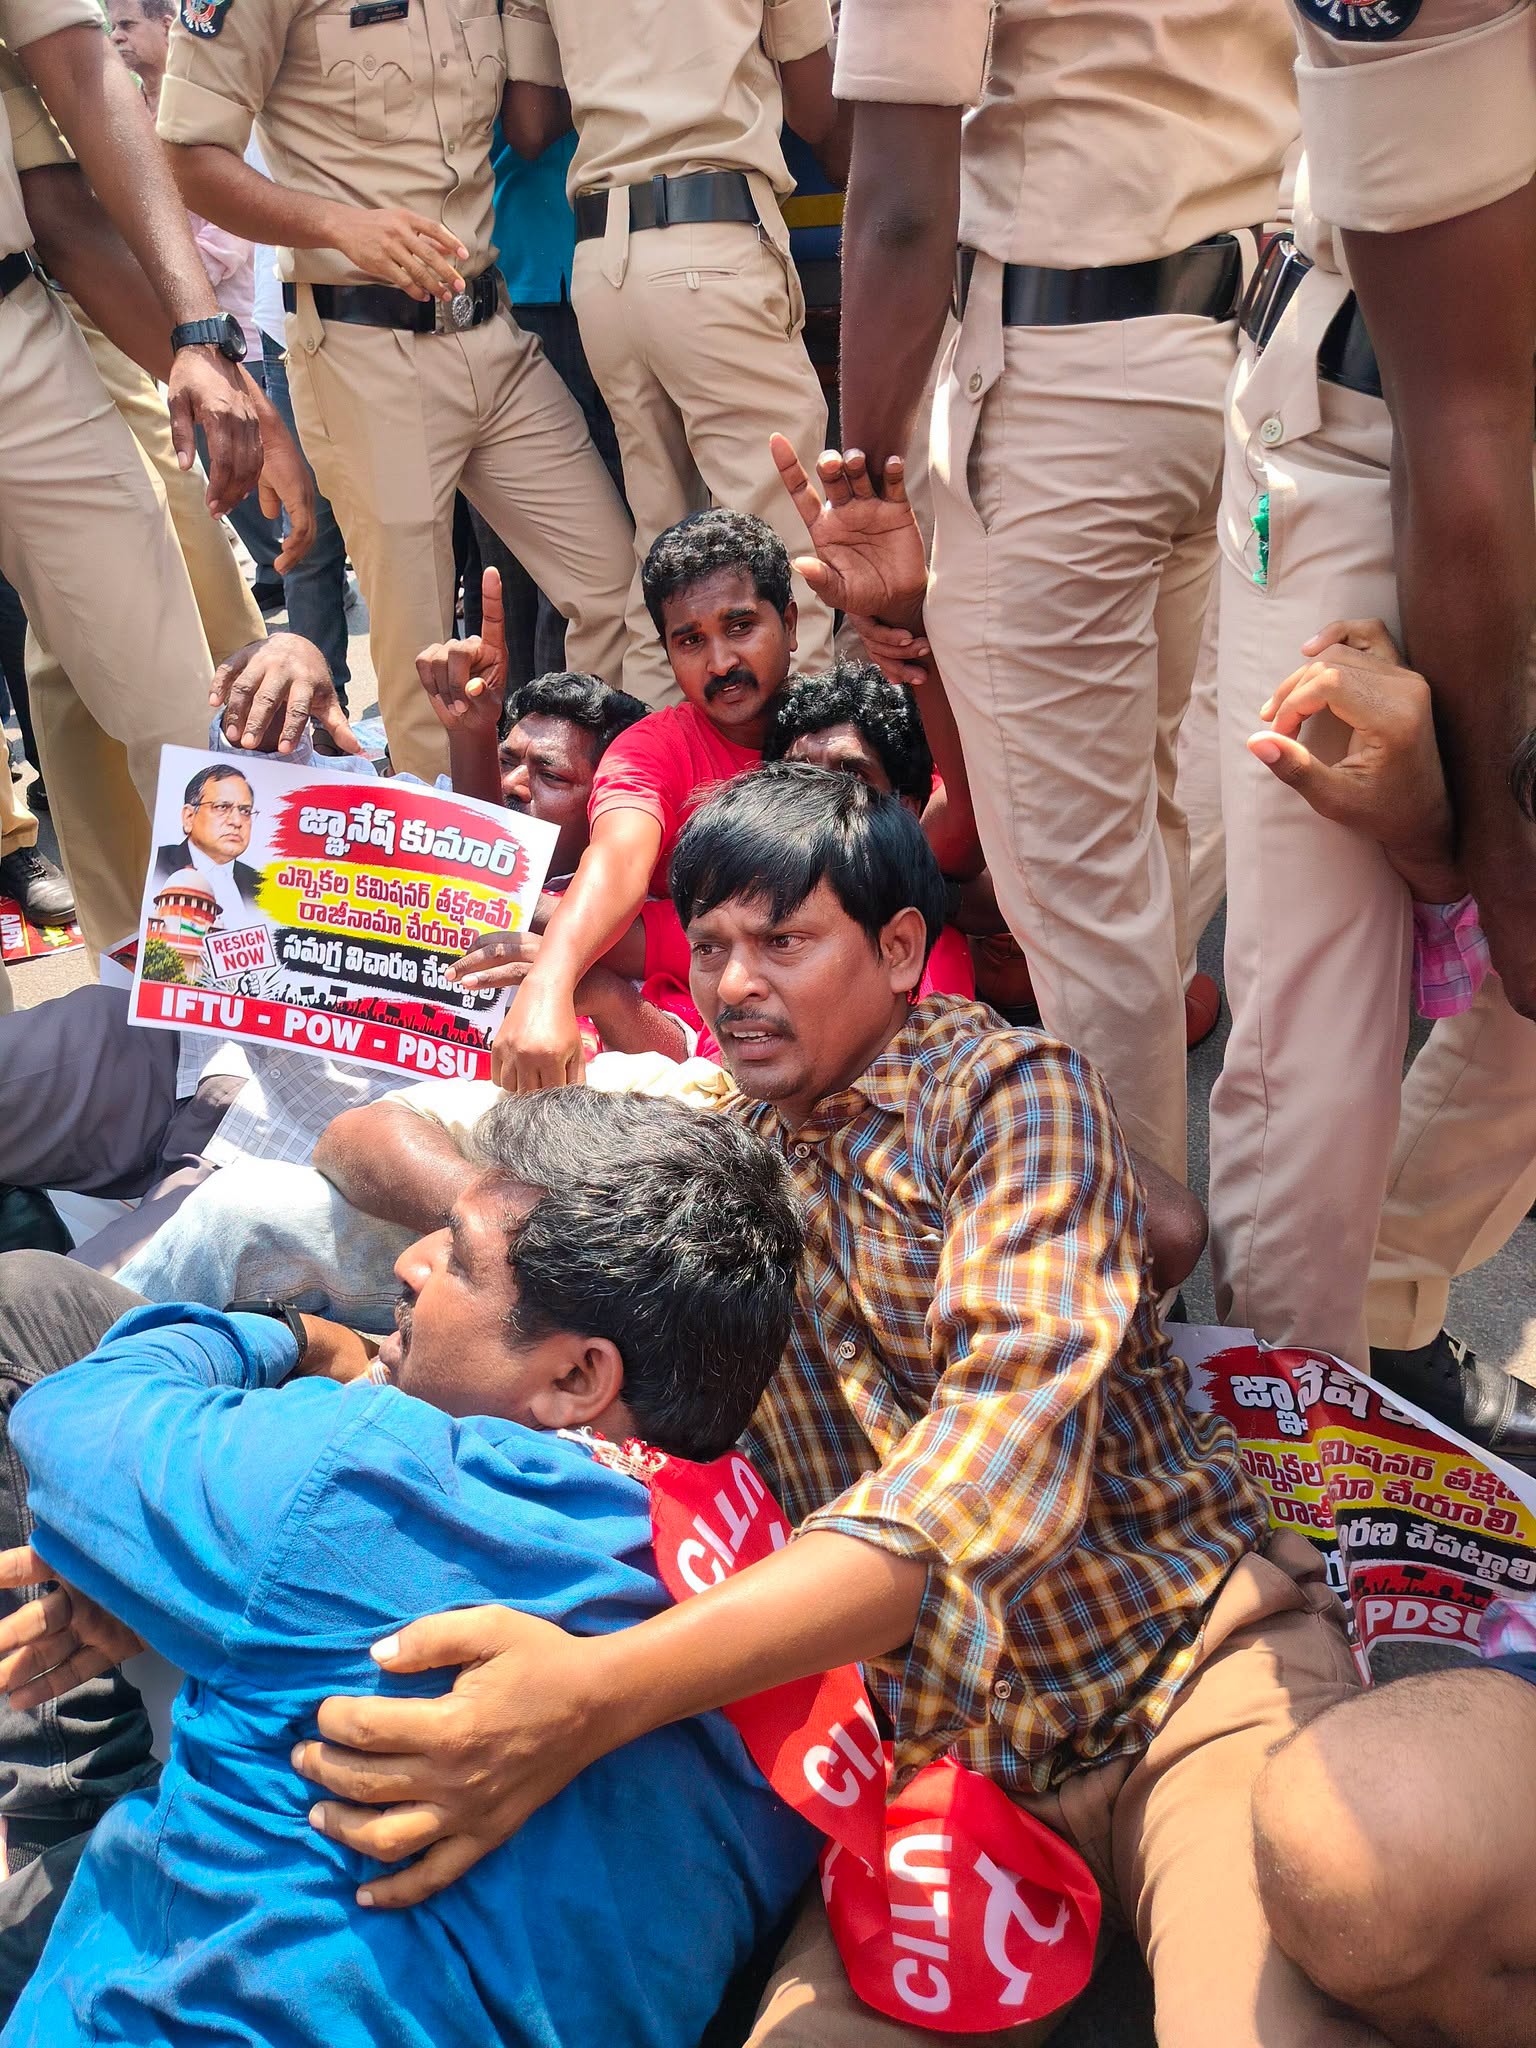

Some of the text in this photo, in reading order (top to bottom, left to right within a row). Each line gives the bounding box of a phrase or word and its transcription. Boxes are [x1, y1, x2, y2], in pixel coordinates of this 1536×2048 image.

[182, 9, 216, 34] POLICE
[1314, 0, 1401, 28] LICE
[298, 802, 520, 876] జ్ఞానేష్ కుమార్
[278, 866, 513, 929] ఎన్నికల కమిషనర్ తక్షణమే
[299, 901, 402, 936] రాజీనామా
[213, 930, 266, 955] RESIGN
[222, 947, 265, 971] NOW
[283, 934, 343, 974] సమగ్ర
[345, 945, 418, 983] విచారణ
[160, 986, 245, 1027] IFTU
[283, 1013, 366, 1052] POW
[397, 1034, 478, 1081] PDSU
[1320, 1439, 1436, 1482] మిషనర్
